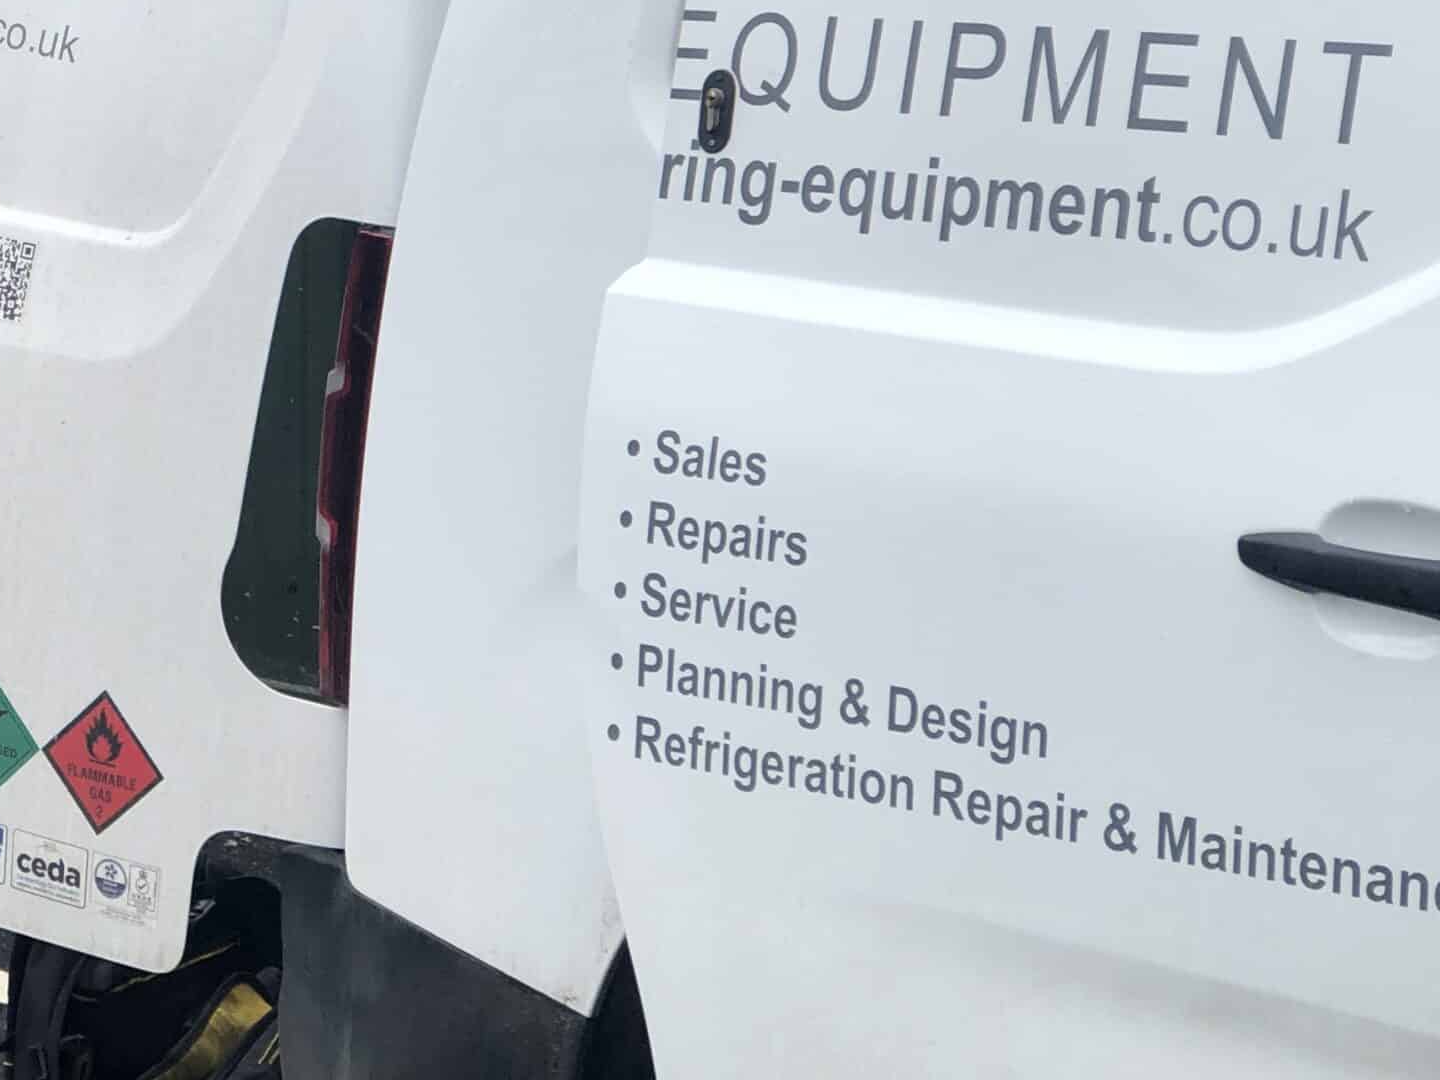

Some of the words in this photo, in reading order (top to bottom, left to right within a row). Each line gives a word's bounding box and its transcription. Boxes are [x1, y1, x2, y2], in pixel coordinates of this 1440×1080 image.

[670, 9, 1393, 144] EQUIPMENT
[652, 429, 768, 487] Sales
[646, 500, 809, 566] Repairs
[640, 572, 799, 639] Service
[636, 643, 824, 730] Planning
[839, 678, 871, 726] &
[887, 685, 1050, 765] Design
[66, 763, 137, 791] FLAMMABLE
[88, 786, 112, 803] GAS
[633, 716, 915, 810] Refrigeration
[932, 770, 1089, 842] Repair
[1102, 802, 1138, 855] &
[1157, 811, 1440, 913] Maintenan
[16, 853, 81, 888] ceda
